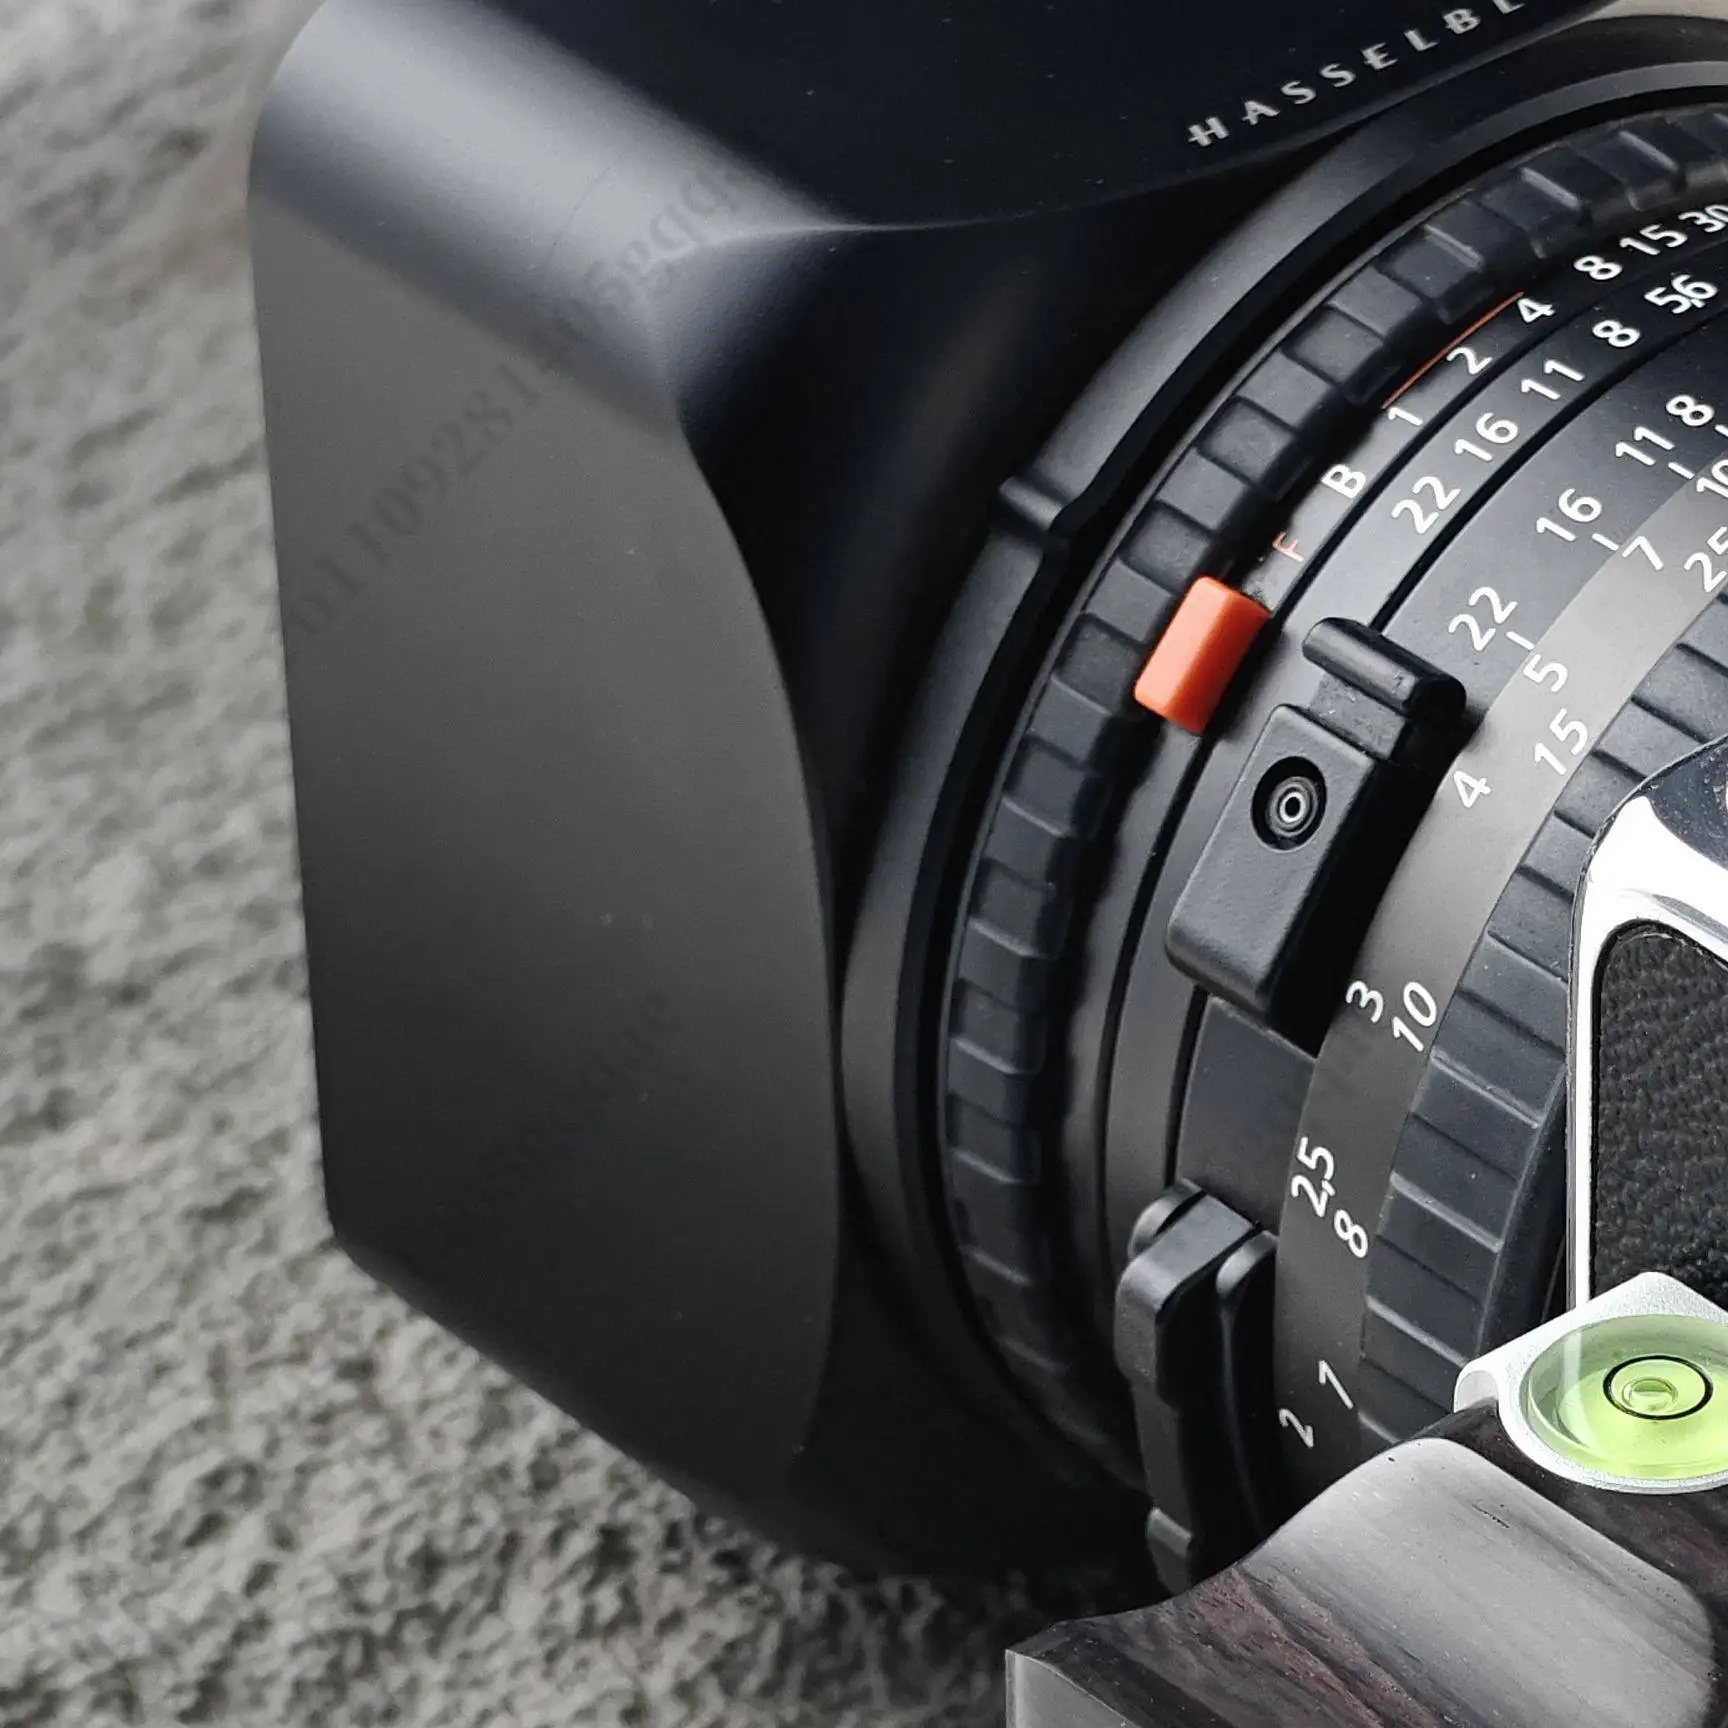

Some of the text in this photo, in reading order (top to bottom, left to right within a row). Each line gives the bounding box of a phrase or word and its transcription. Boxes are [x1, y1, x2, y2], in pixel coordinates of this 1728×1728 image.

[1321, 464, 1367, 499] B
[1388, 406, 1423, 426] 1
[1446, 347, 1493, 375] 2
[1517, 298, 1556, 323] 4
[1574, 255, 1623, 281] 8
[1619, 224, 1688, 256] 15
[1391, 476, 1461, 534] 22
[1454, 412, 1518, 461] 16
[1520, 359, 1586, 400] 11
[1592, 319, 1641, 348] 8
[1448, 586, 1518, 652] 22
[1536, 488, 1602, 542] 16
[1615, 425, 1675, 466] 11
[1665, 394, 1715, 427] 8
[1278, 1408, 1315, 1449] 2
[1345, 981, 1384, 1023] 3
[1453, 770, 1492, 809] 4
[1523, 653, 1569, 693] 5
[1622, 535, 1664, 571] 7
[1333, 1209, 1369, 1259] 8
[1391, 981, 1438, 1052] 10
[1534, 708, 1590, 776] 15
